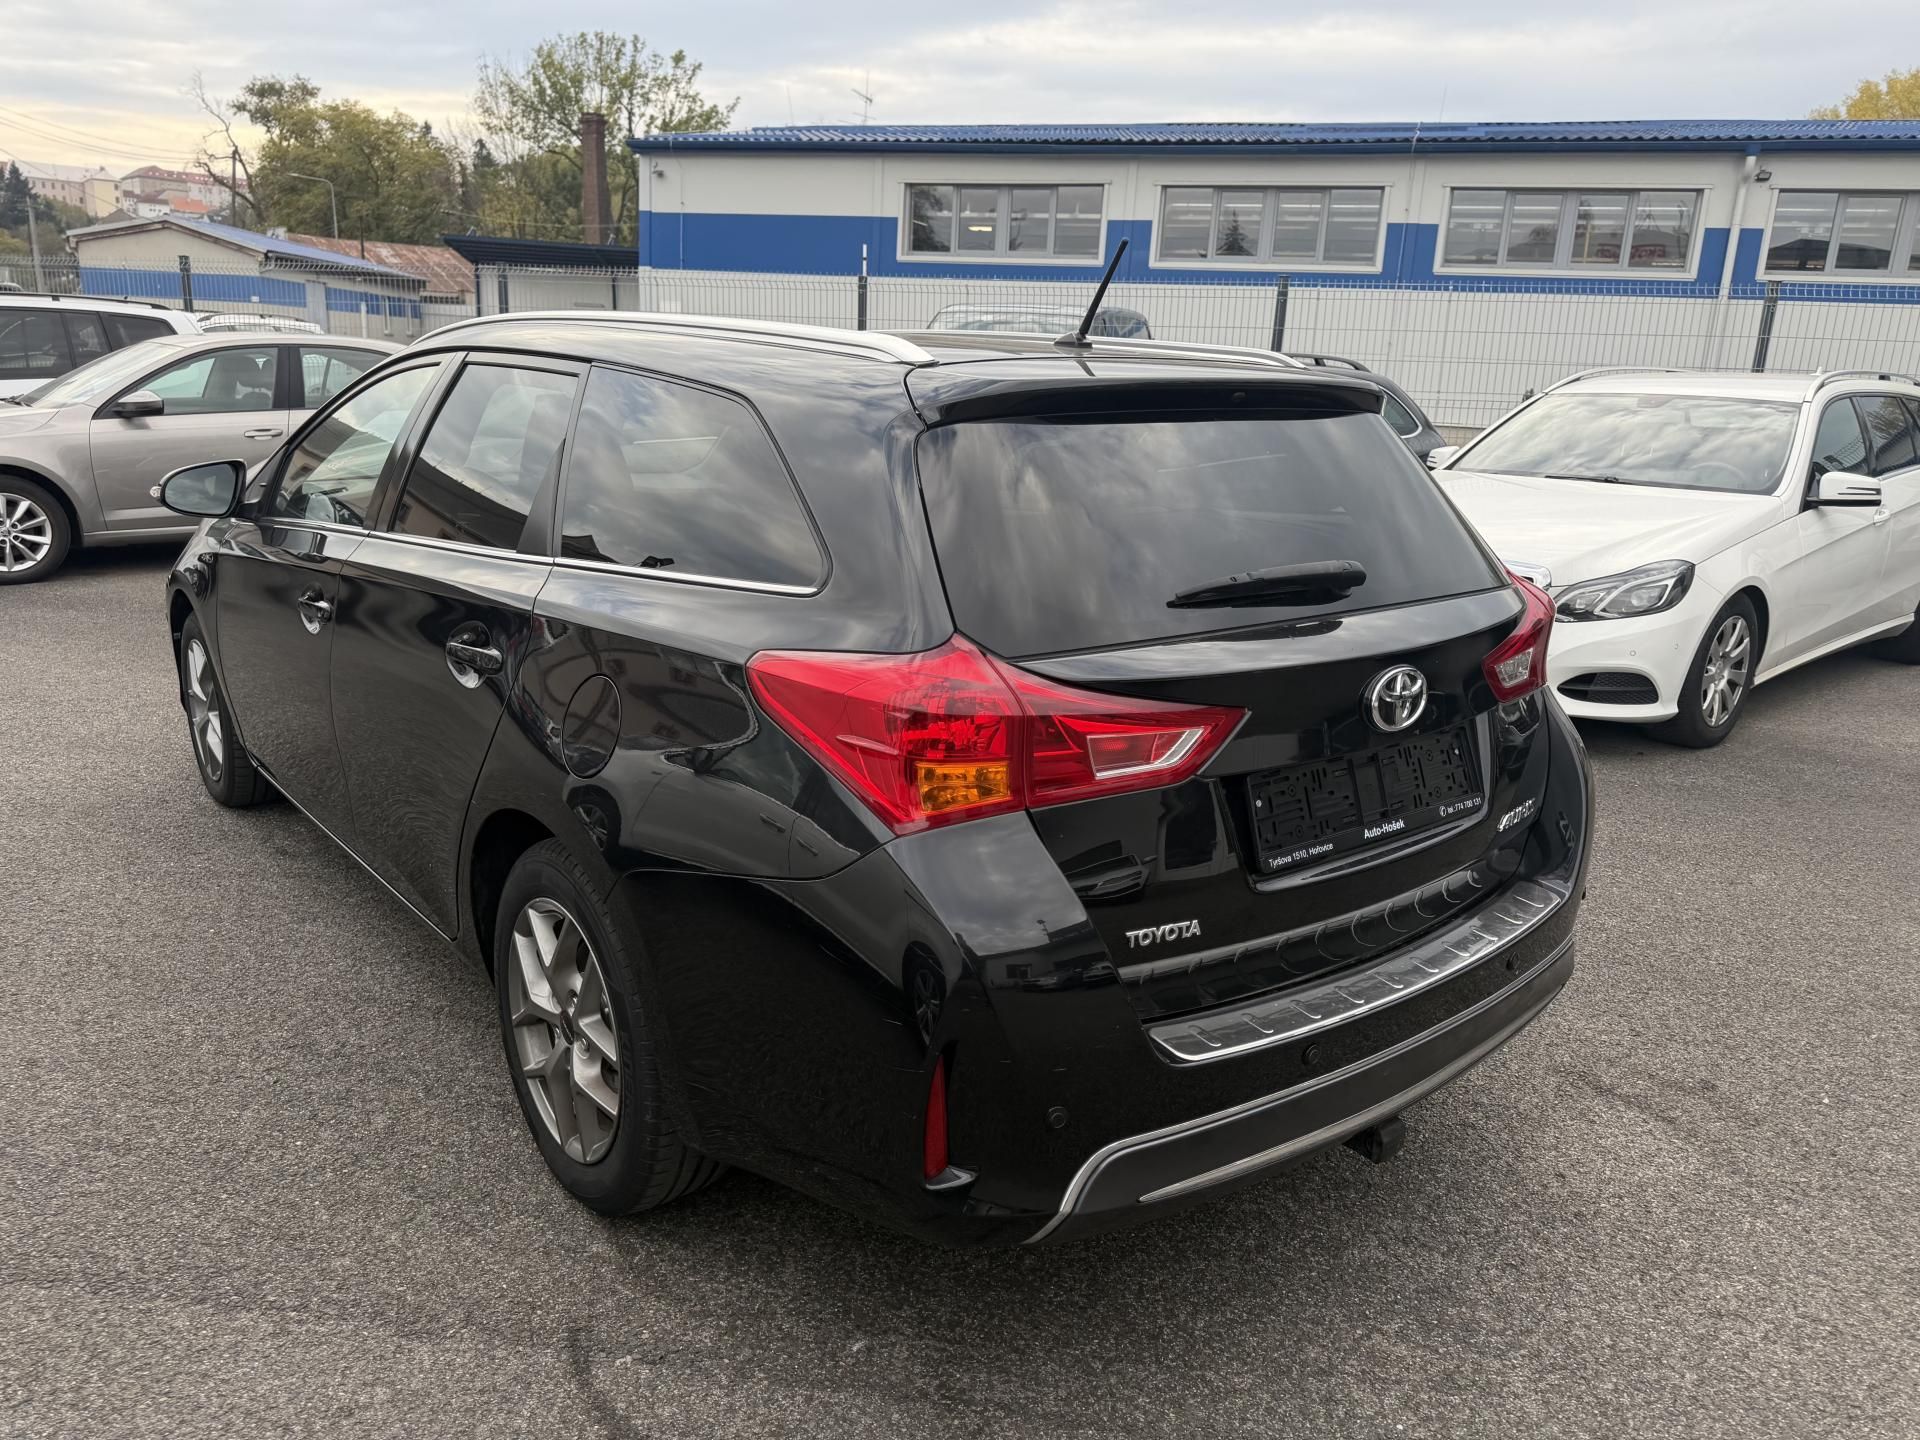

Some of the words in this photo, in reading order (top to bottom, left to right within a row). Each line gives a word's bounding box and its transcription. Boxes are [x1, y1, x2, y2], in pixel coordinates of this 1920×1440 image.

[1364, 818, 1405, 840] Auto-Hošek
[1268, 855, 1292, 869] Tyršova
[1292, 849, 1309, 861] 1510,
[1308, 843, 1334, 856] Hořovice
[1125, 919, 1201, 949] TOYOTA
